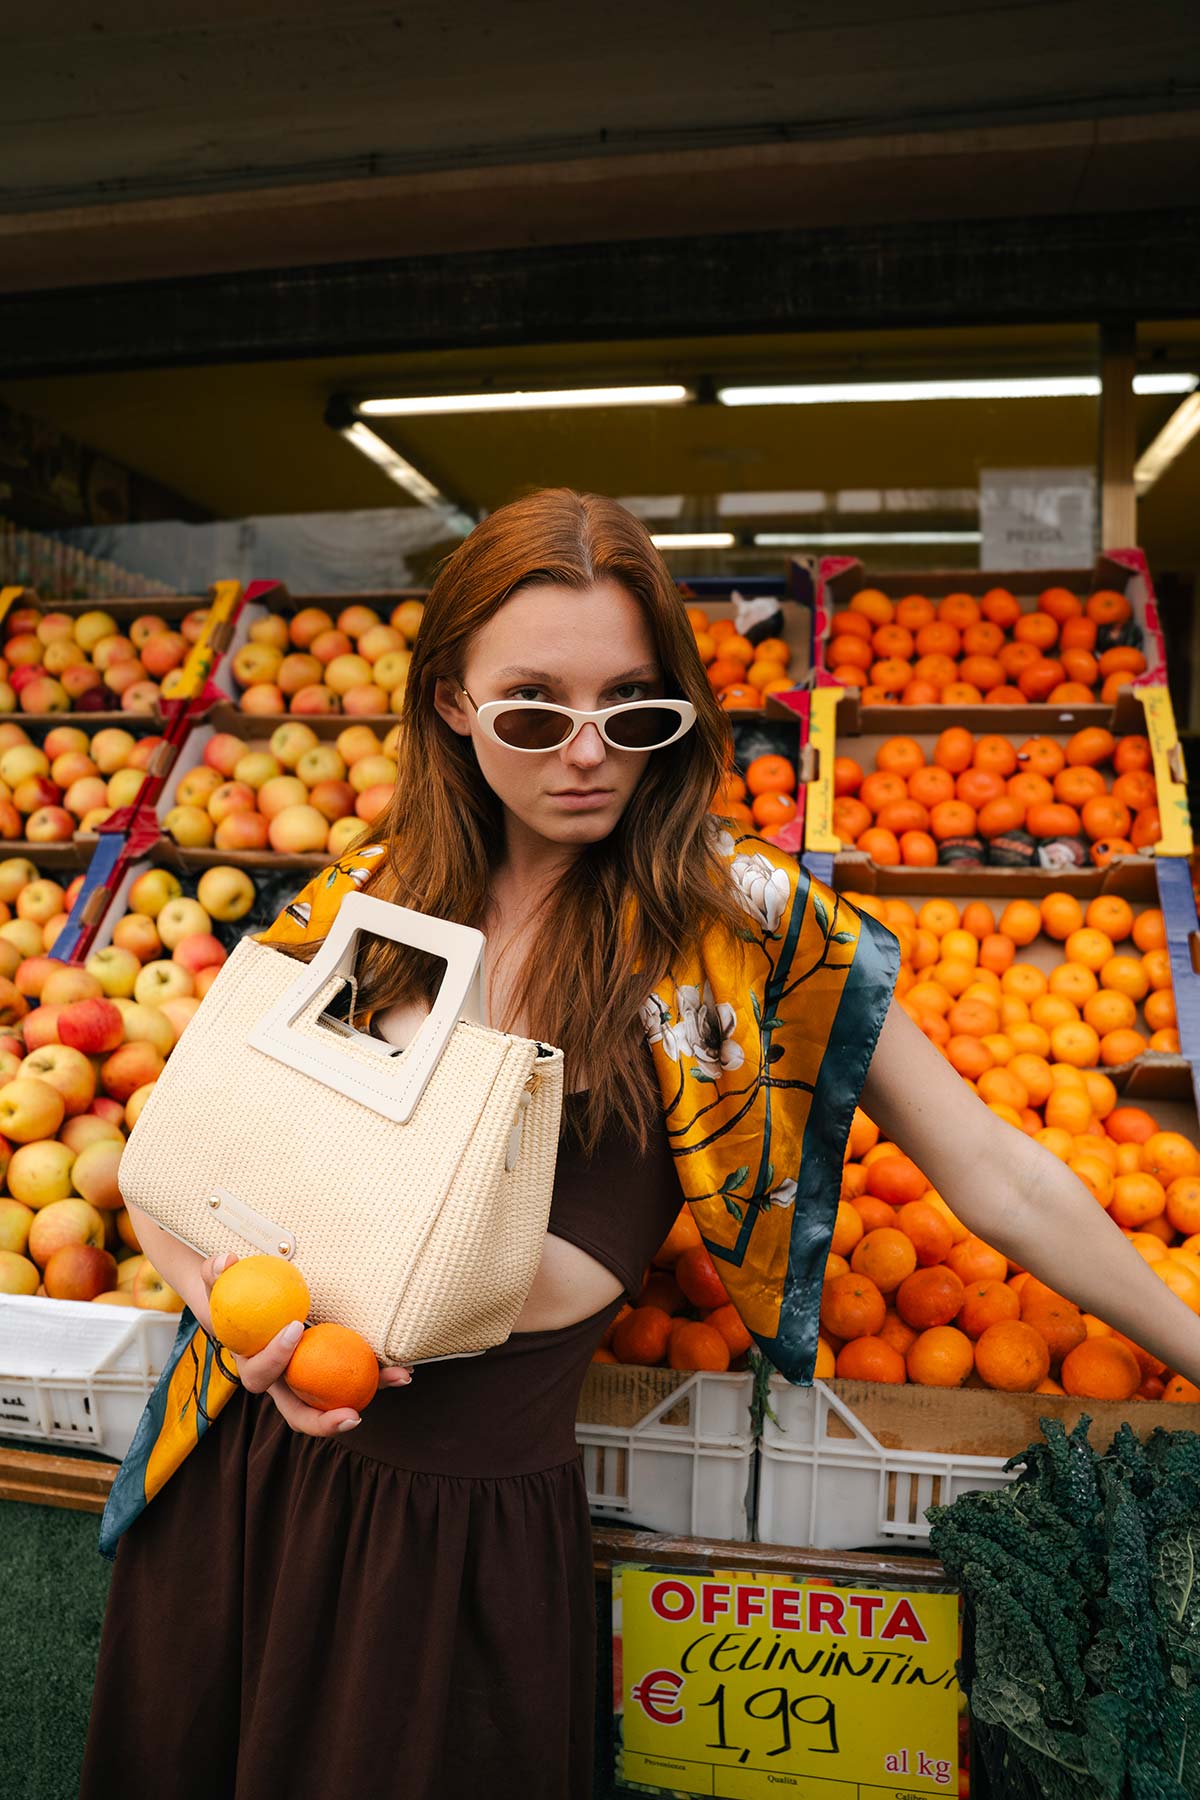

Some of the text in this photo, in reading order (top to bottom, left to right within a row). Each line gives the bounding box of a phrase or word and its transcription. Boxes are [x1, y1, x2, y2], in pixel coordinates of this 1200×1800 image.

[651, 1580, 928, 1642] OFFERTA
[631, 1670, 840, 1763] € 1,99
[886, 1750, 951, 1784] al kg
